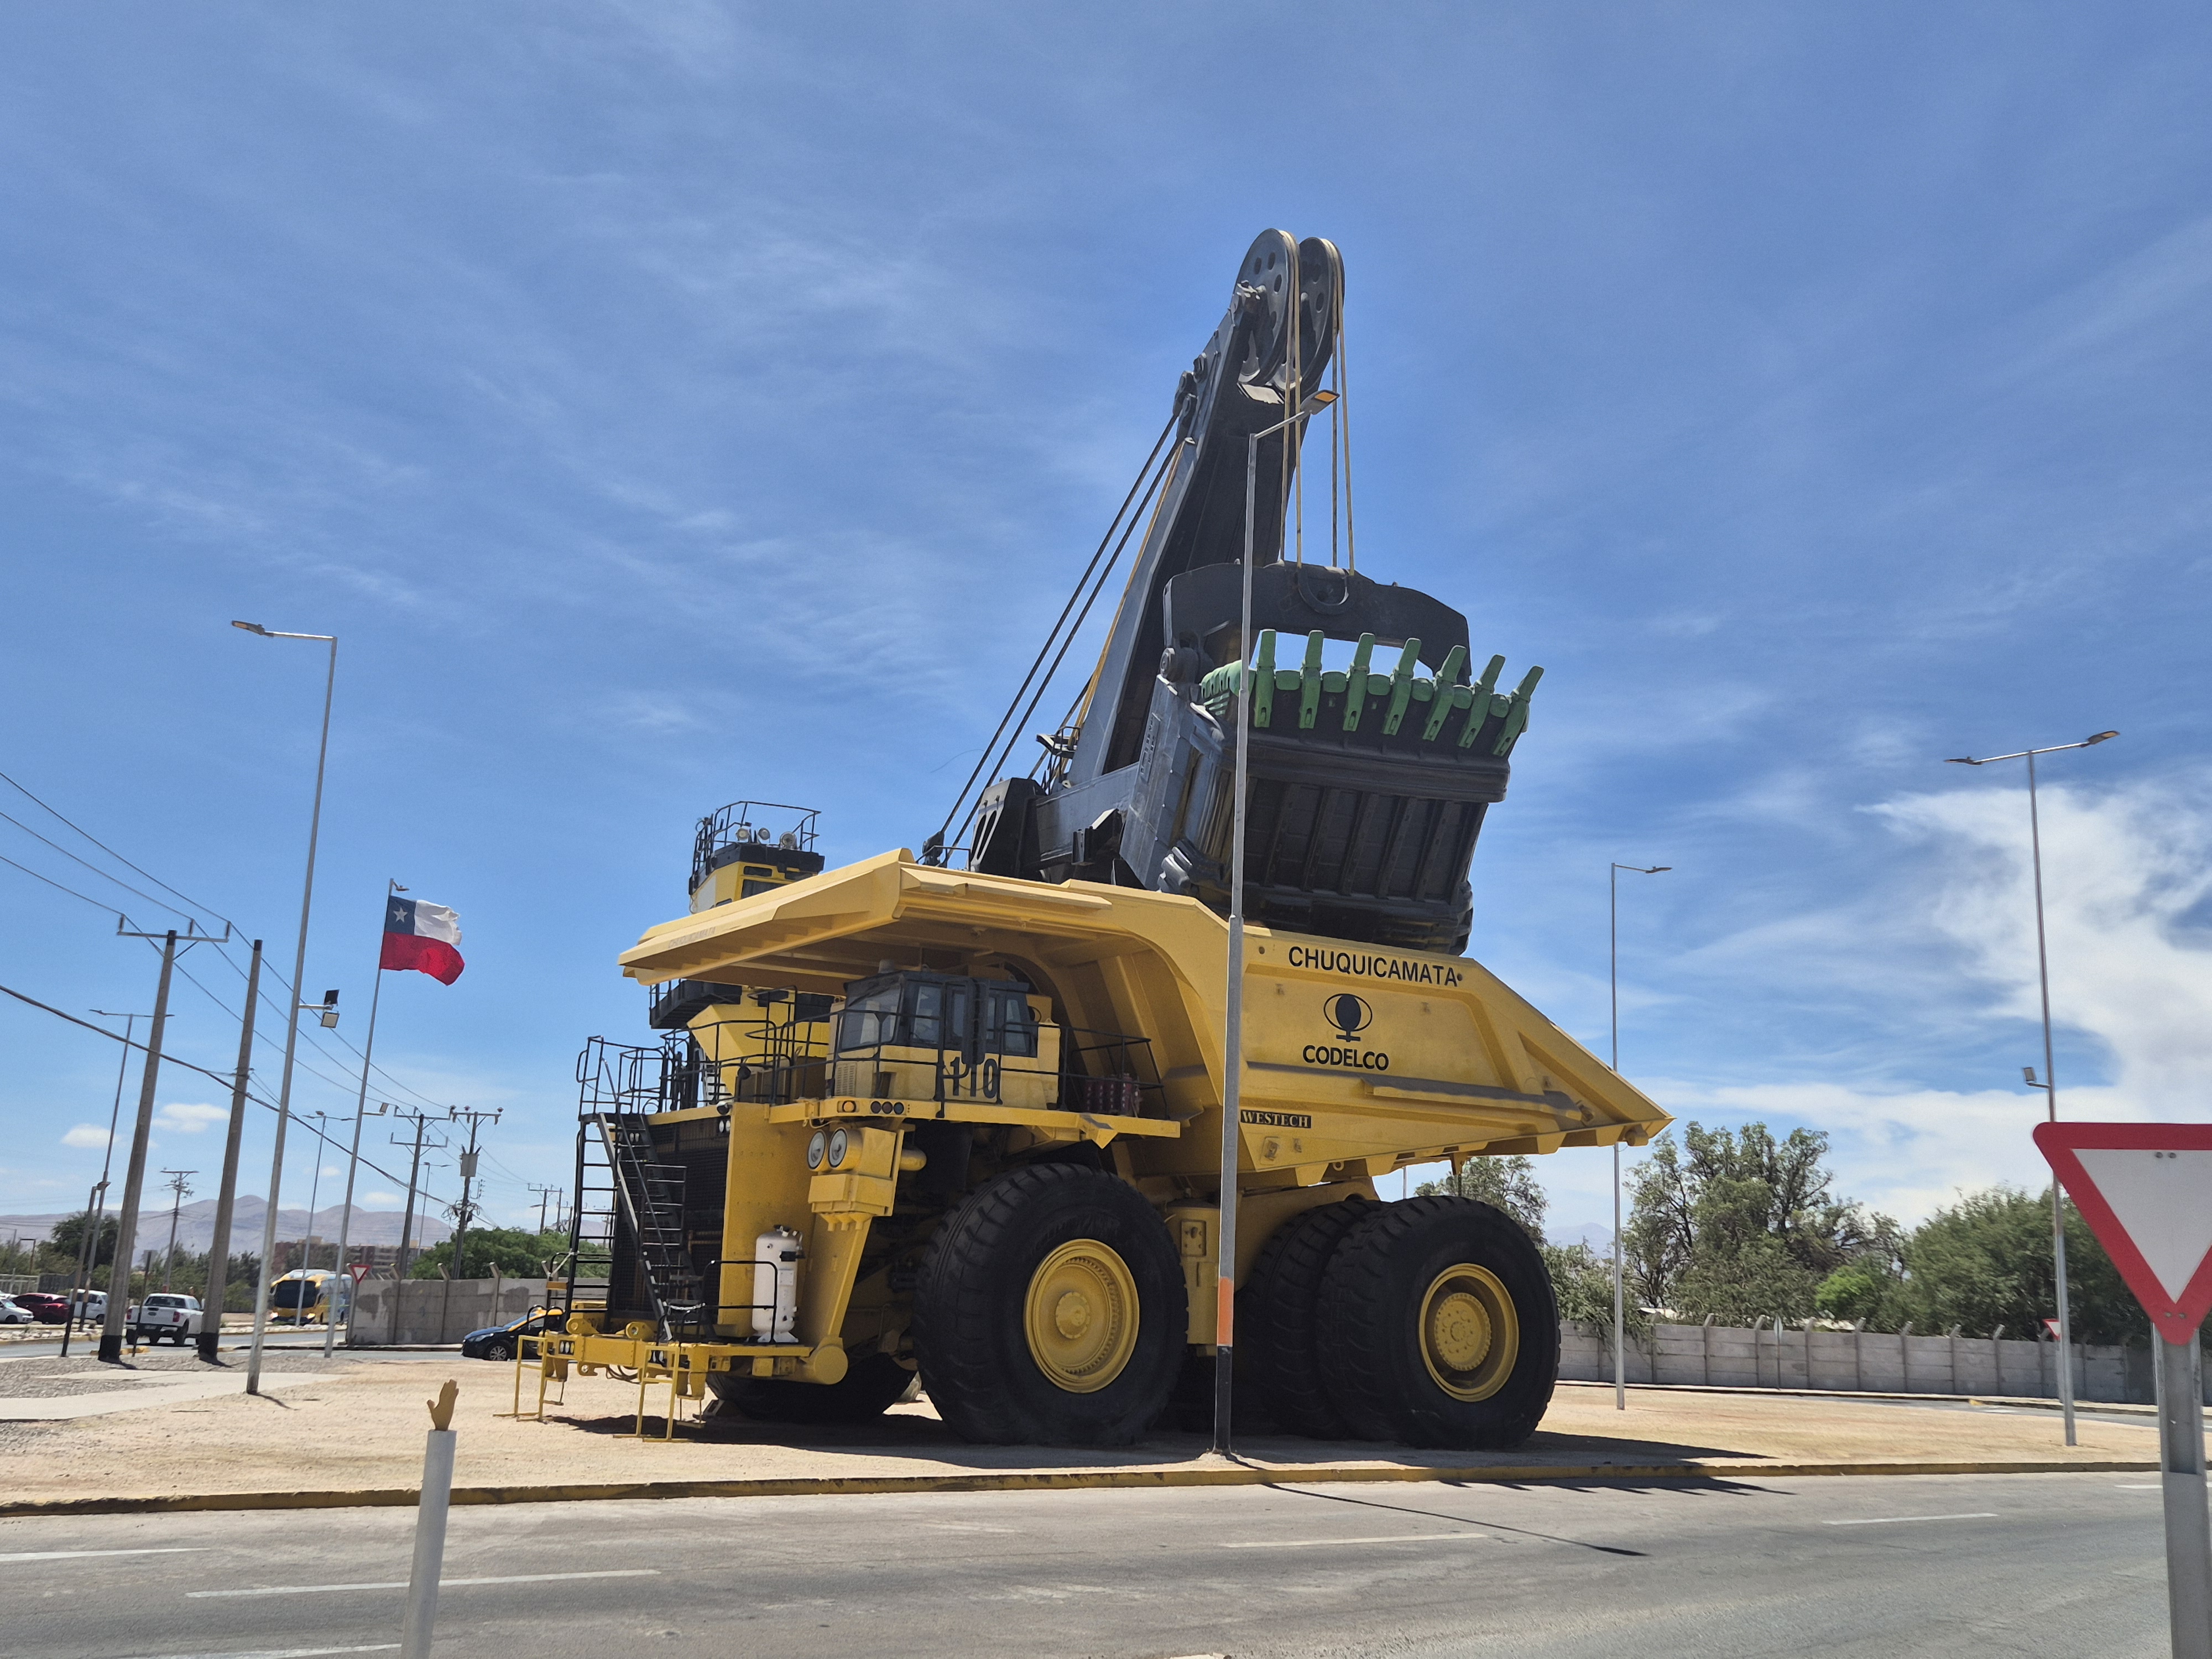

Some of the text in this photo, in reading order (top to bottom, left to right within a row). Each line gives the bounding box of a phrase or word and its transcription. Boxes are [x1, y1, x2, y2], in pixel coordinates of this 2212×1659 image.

[1288, 946, 1458, 987] CHUQUICAMATA
[1302, 1045, 1389, 1071] CODELCO
[950, 1056, 998, 1099] 110
[1242, 1110, 1309, 1128] WESTECH
